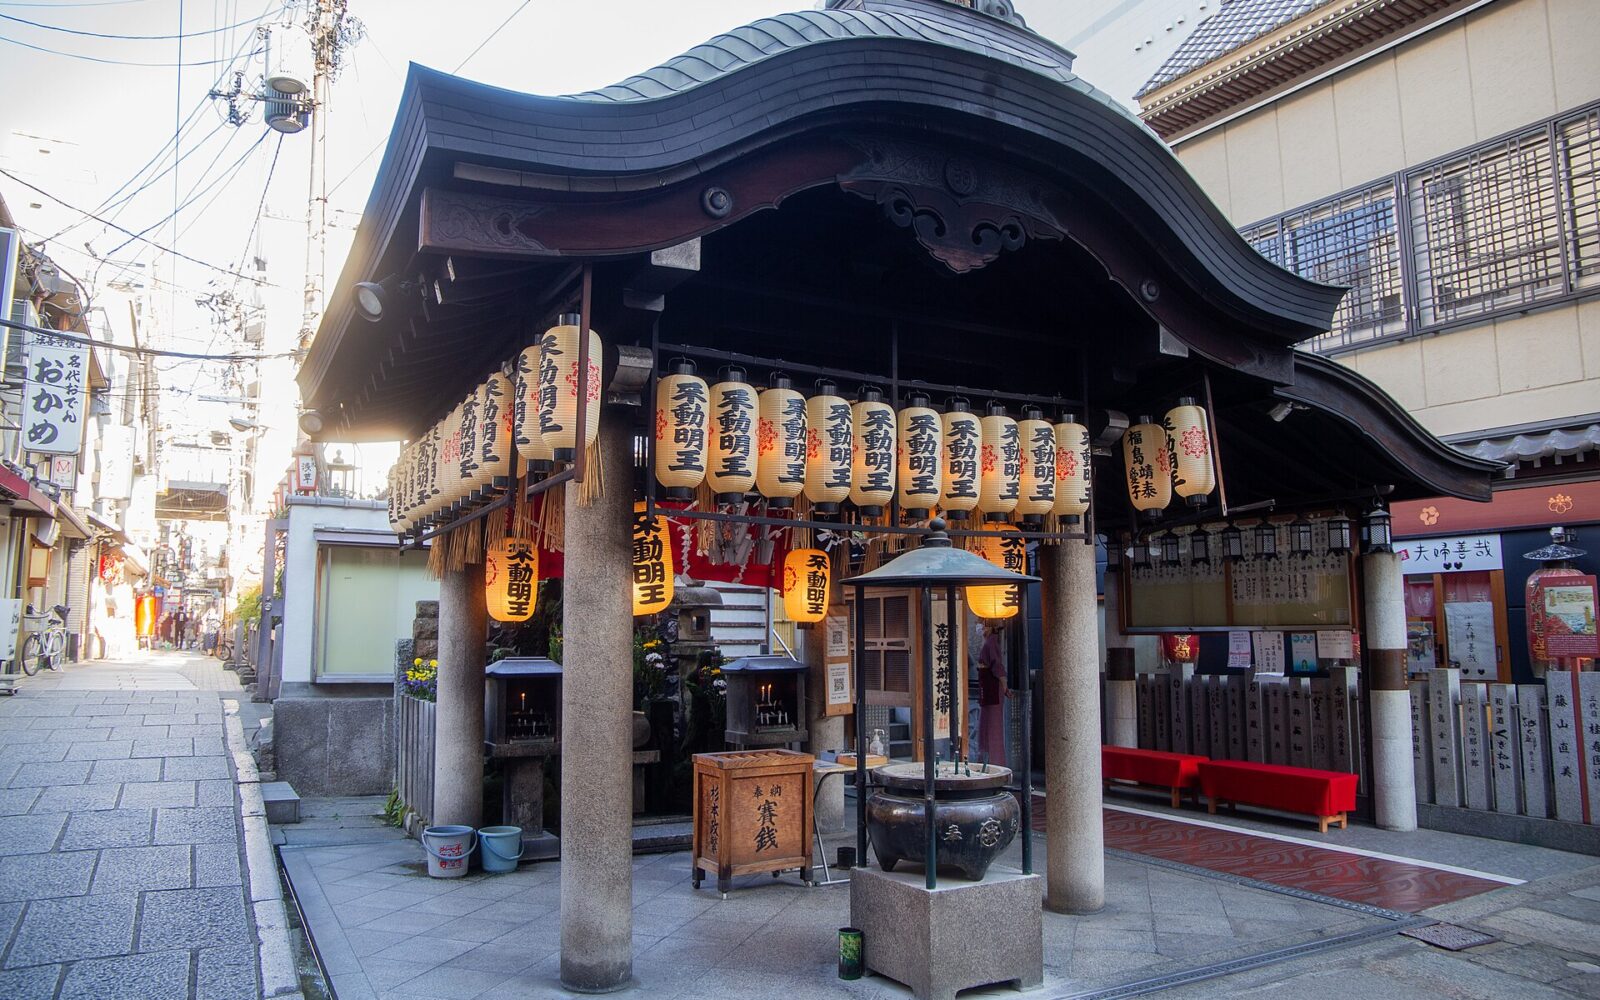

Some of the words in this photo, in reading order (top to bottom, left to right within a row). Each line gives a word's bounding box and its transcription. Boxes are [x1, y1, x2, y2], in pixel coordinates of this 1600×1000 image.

[28, 357, 64, 445] おかめ
[62, 354, 81, 423] 名代おでん
[668, 382, 707, 472] 不動明王
[715, 389, 754, 478] 不動明王
[778, 399, 807, 485] 不動明王
[824, 404, 852, 488] 不動明王
[860, 410, 894, 492] 不動明王
[905, 414, 939, 495] 不動明王
[946, 419, 979, 499] 不動明王
[999, 424, 1020, 500] 不動明王
[1029, 427, 1055, 502] 不動明王
[1127, 431, 1144, 465] 福島
[1129, 467, 1141, 499] 愛子
[506, 542, 535, 616] 不動明王
[633, 510, 667, 605] 不動明王
[806, 554, 829, 615] 不動明王
[1000, 530, 1025, 607] 不動王
[1413, 539, 1494, 562] 夫婦善哉
[1465, 622, 1478, 663] 夫婦善哉
[1555, 694, 1574, 778] 藤山直美
